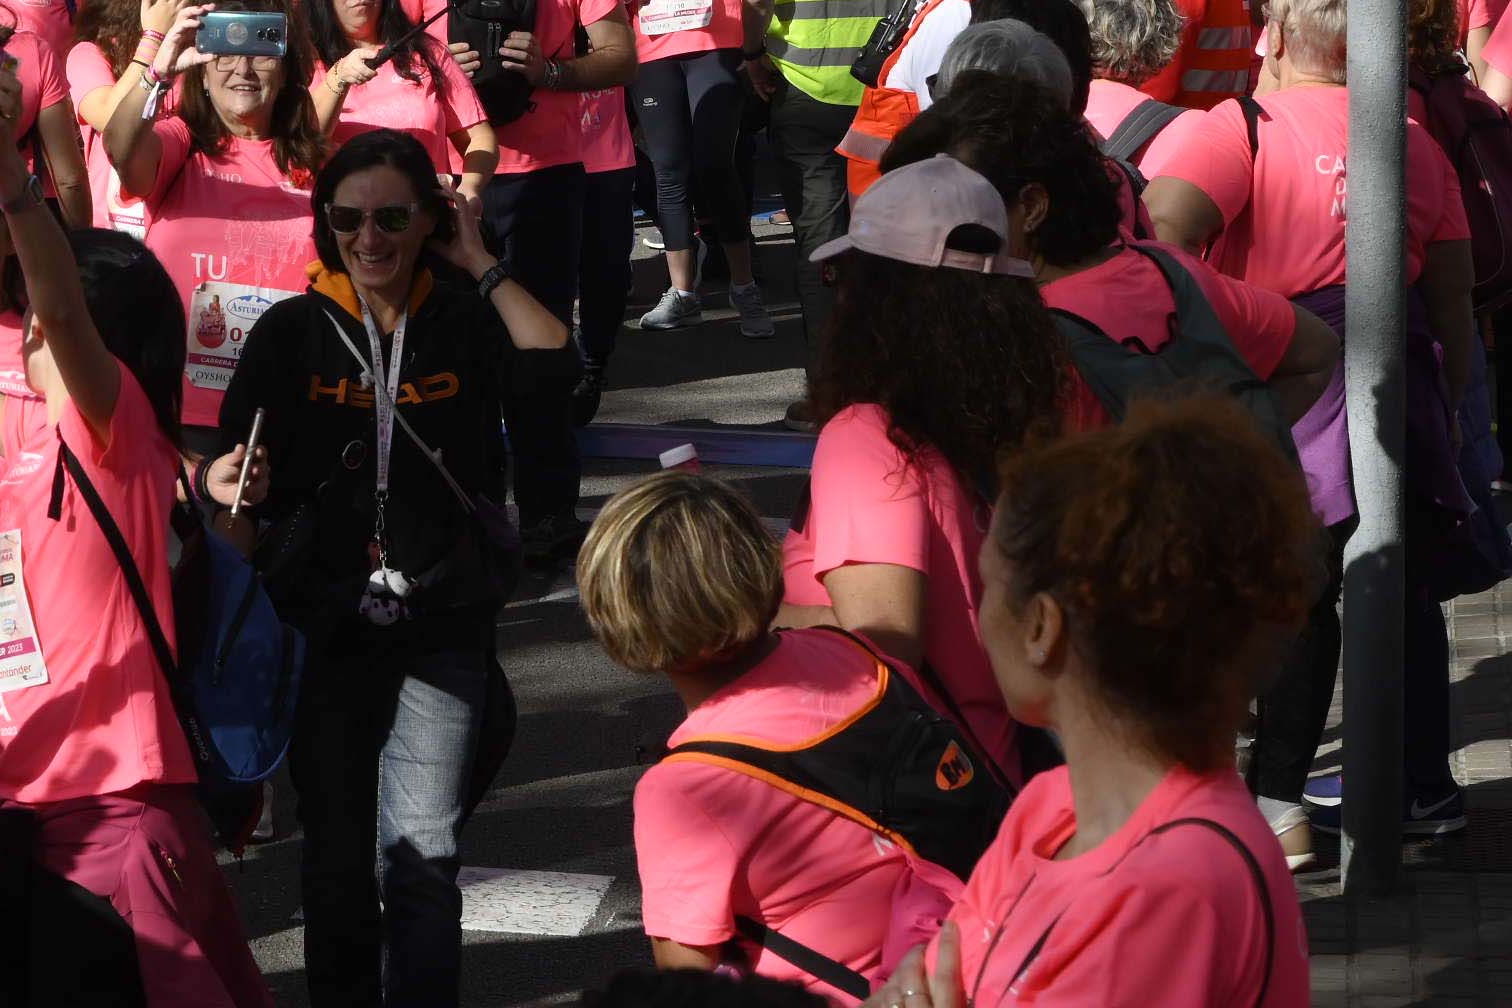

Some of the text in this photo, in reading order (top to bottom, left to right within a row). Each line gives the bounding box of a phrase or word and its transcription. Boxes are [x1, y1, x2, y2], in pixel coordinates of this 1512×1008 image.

[1315, 154, 1346, 175] CA
[1336, 176, 1347, 196] D
[190, 252, 228, 280] TU
[200, 356, 232, 368] CARRERA
